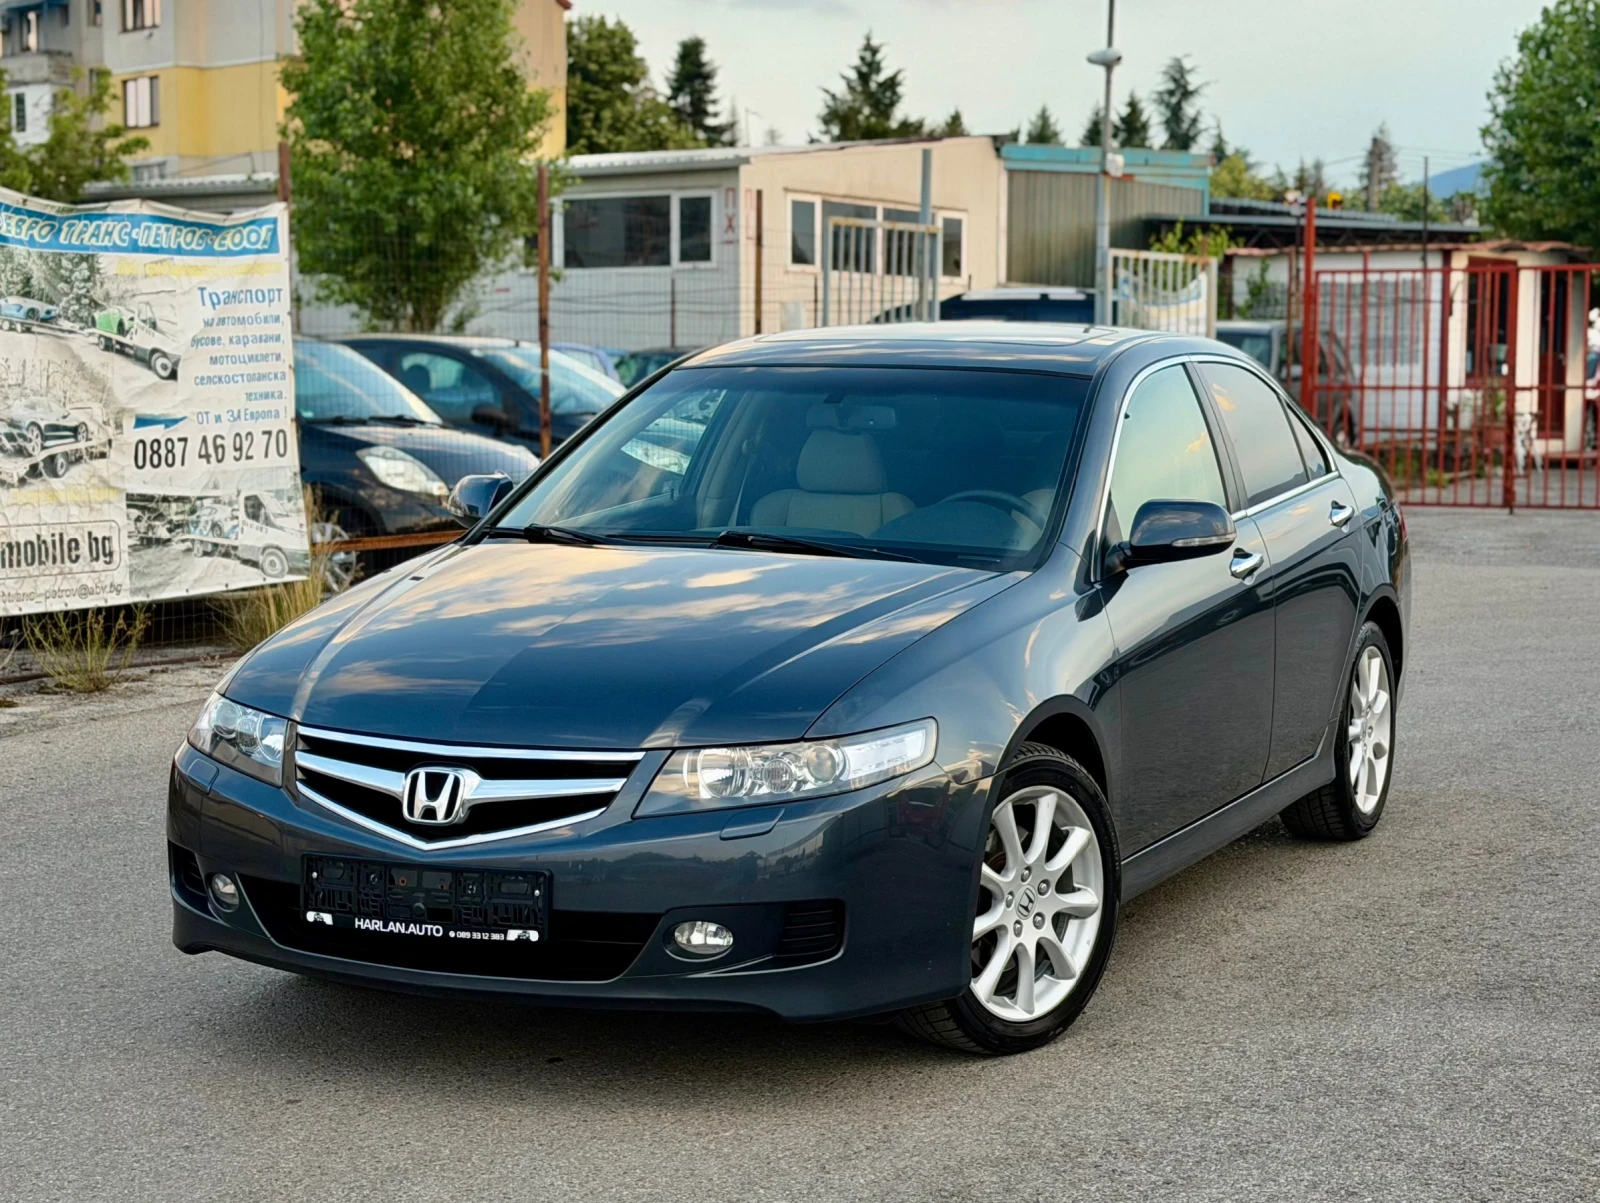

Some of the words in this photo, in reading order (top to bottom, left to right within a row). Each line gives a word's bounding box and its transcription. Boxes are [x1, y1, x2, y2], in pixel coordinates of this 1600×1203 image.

[197, 286, 283, 311] Транспорт
[203, 317, 214, 328] на
[228, 333, 284, 348] каравани,
[209, 352, 285, 366] мотоциклети,
[194, 370, 286, 386] селскостопанска
[244, 389, 287, 402] техника.
[196, 411, 210, 425] ОТ
[214, 413, 222, 424] и
[134, 437, 188, 470] 0887
[198, 433, 226, 465] 46
[233, 431, 254, 462] 92
[262, 428, 288, 458] 70
[354, 917, 443, 937] HARLAN.AUTO
[456, 931, 471, 939] 089
[482, 932, 489, 940] 12
